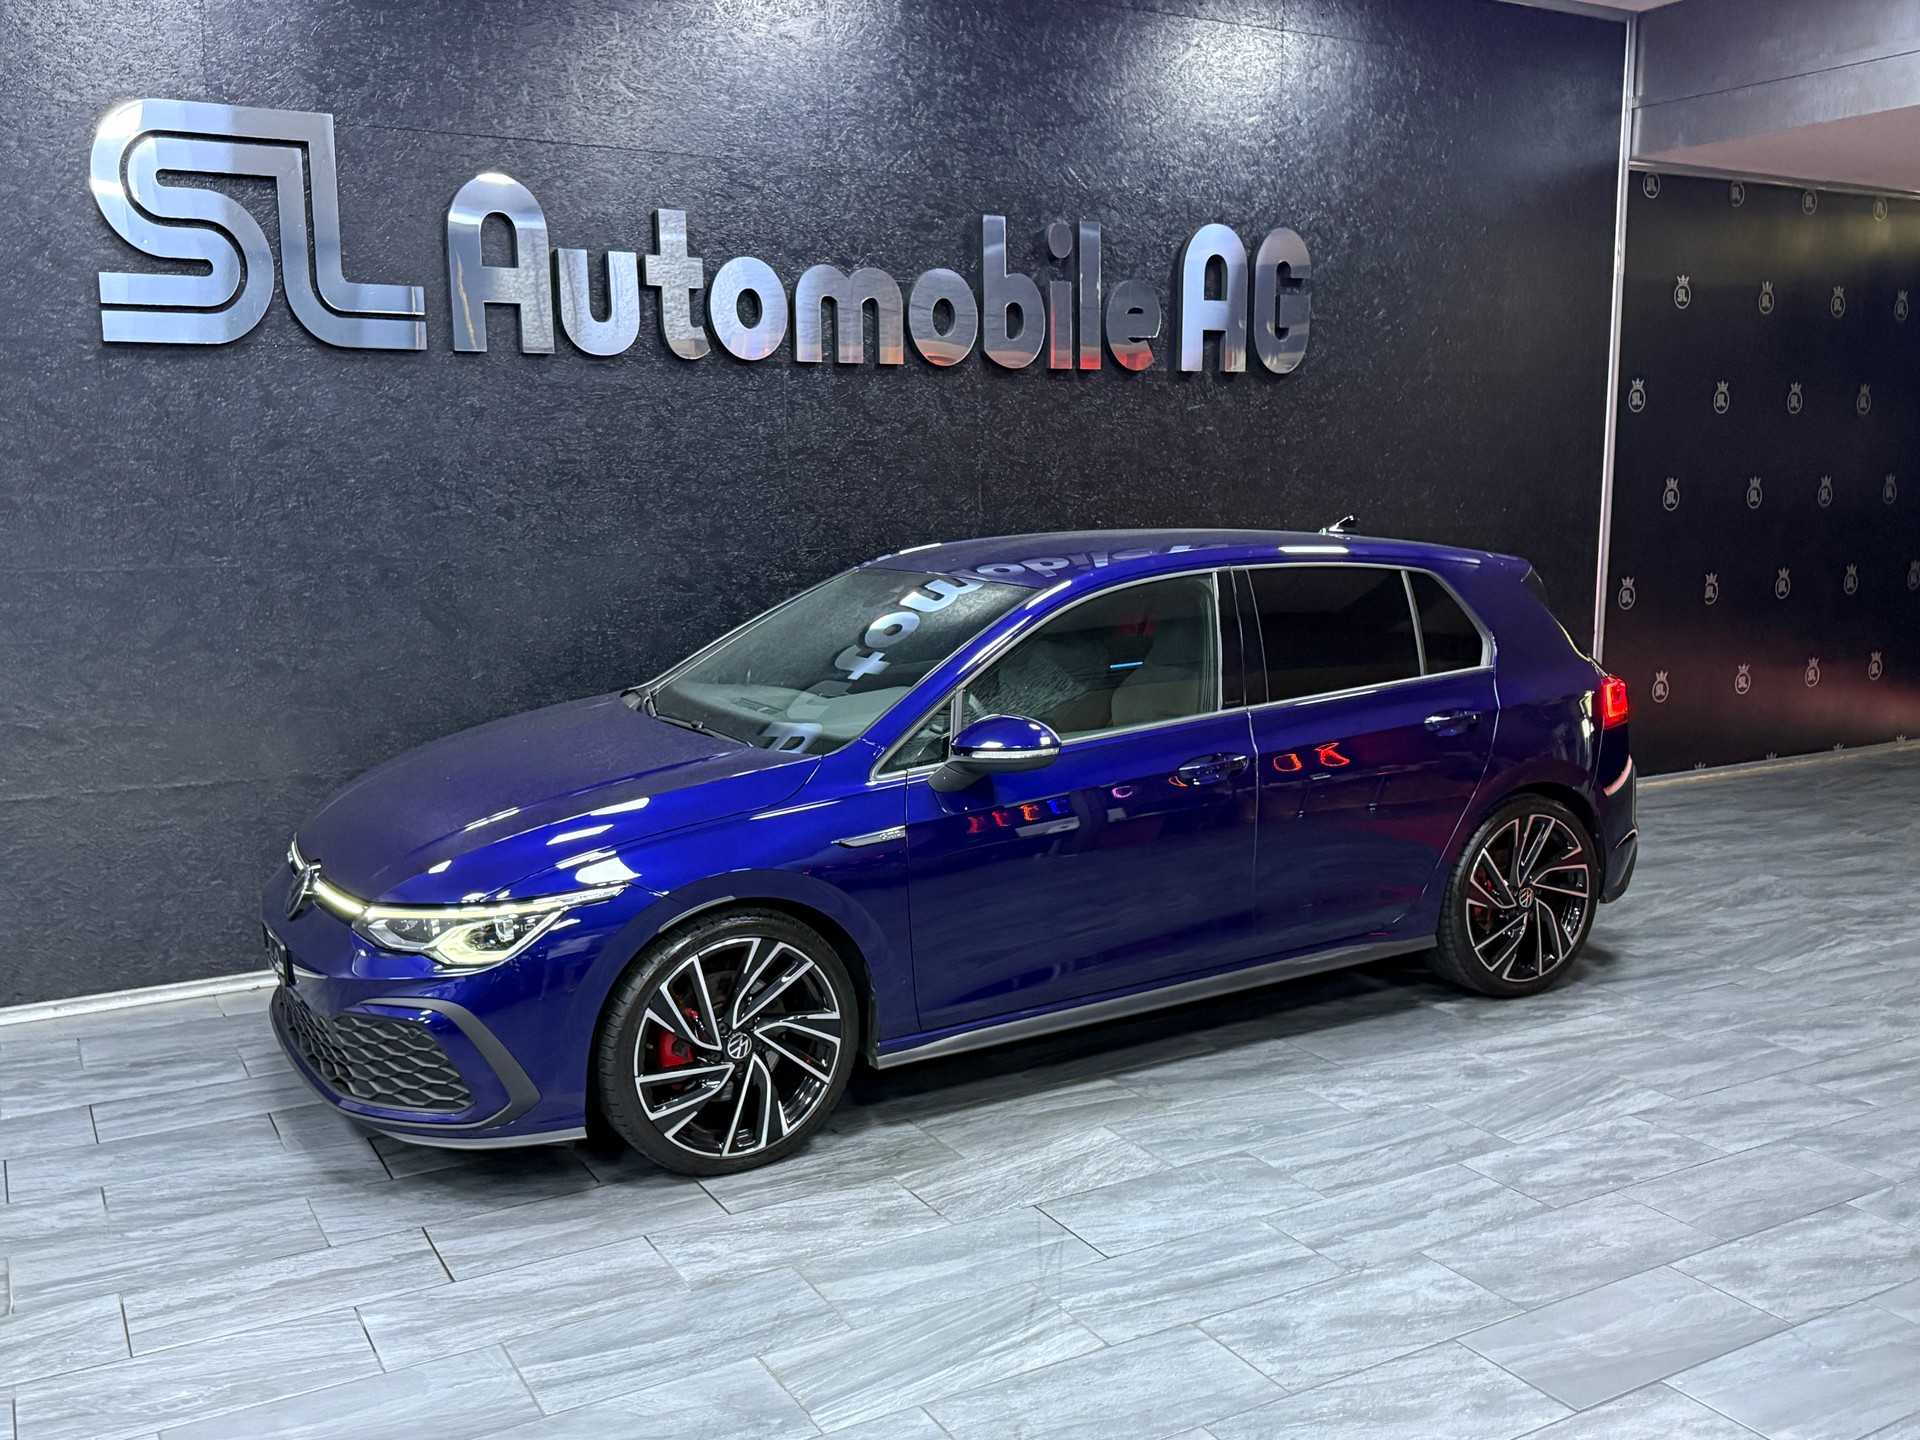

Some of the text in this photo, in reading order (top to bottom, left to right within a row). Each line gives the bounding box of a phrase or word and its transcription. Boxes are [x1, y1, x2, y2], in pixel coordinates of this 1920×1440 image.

[90, 98, 1312, 374] SL Automobile AG
